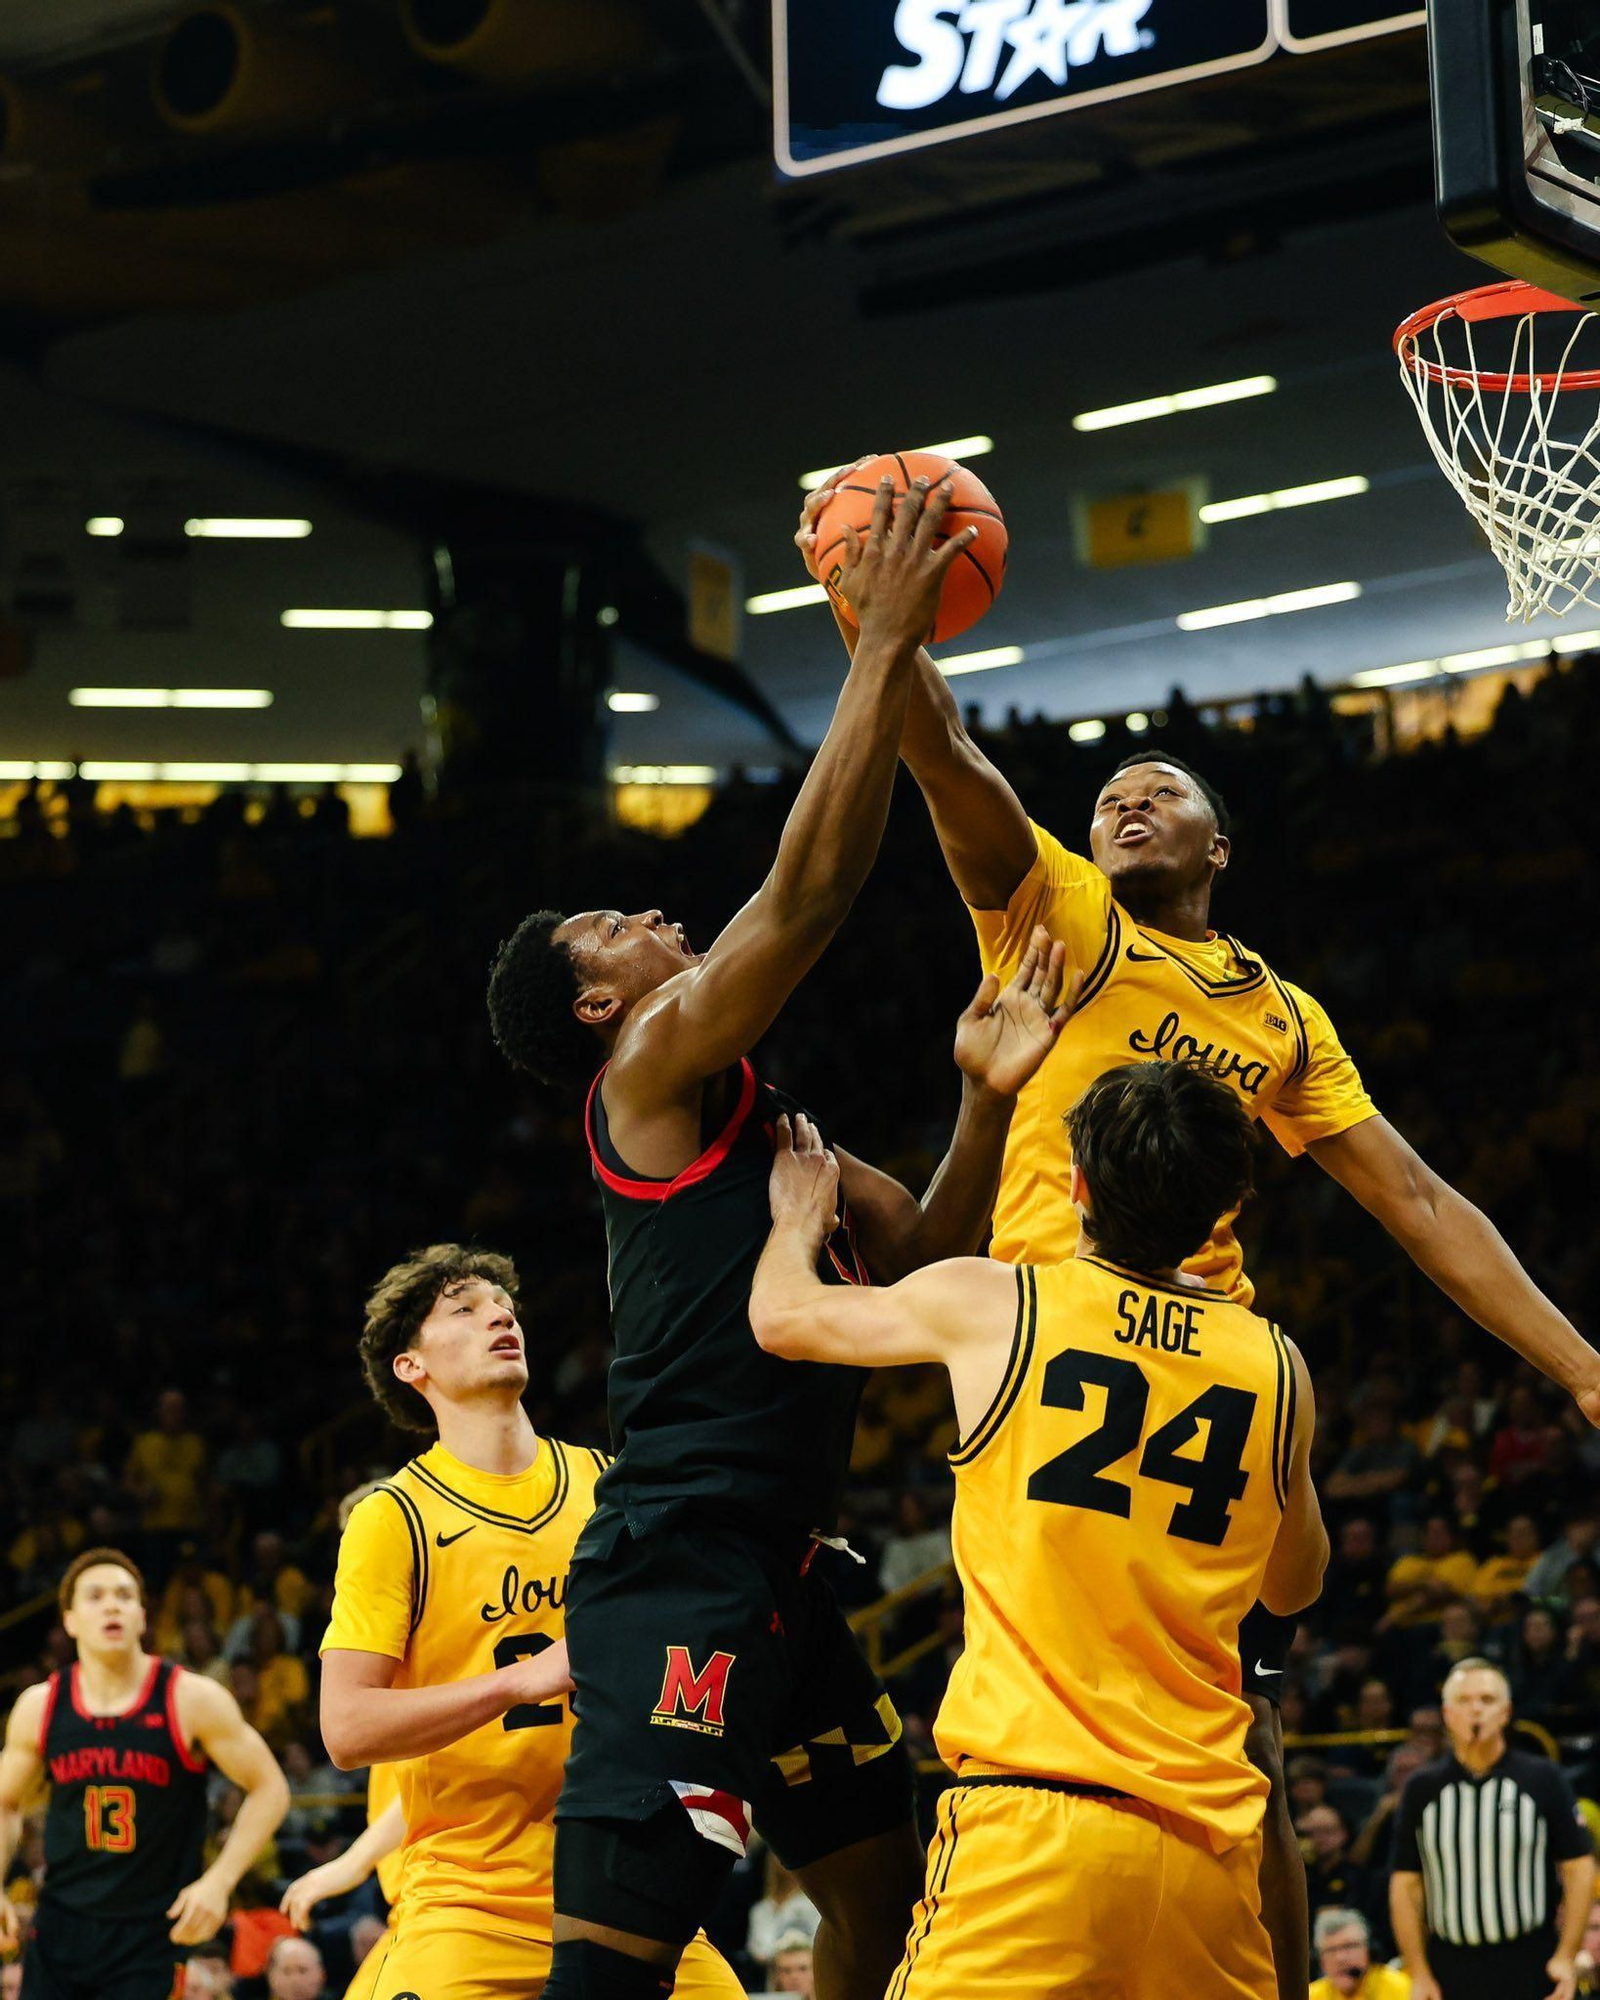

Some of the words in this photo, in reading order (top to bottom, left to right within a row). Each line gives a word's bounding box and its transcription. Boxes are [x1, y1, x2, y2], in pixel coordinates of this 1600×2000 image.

[876, 0, 1152, 110] STAR
[1129, 1012, 1270, 1095] Iowa
[1114, 1290, 1204, 1357] SAGE
[1027, 1348, 1258, 1547] 24
[652, 1646, 737, 1726] M
[50, 1747, 170, 1787] MARYLAND
[83, 1785, 136, 1853] 13
